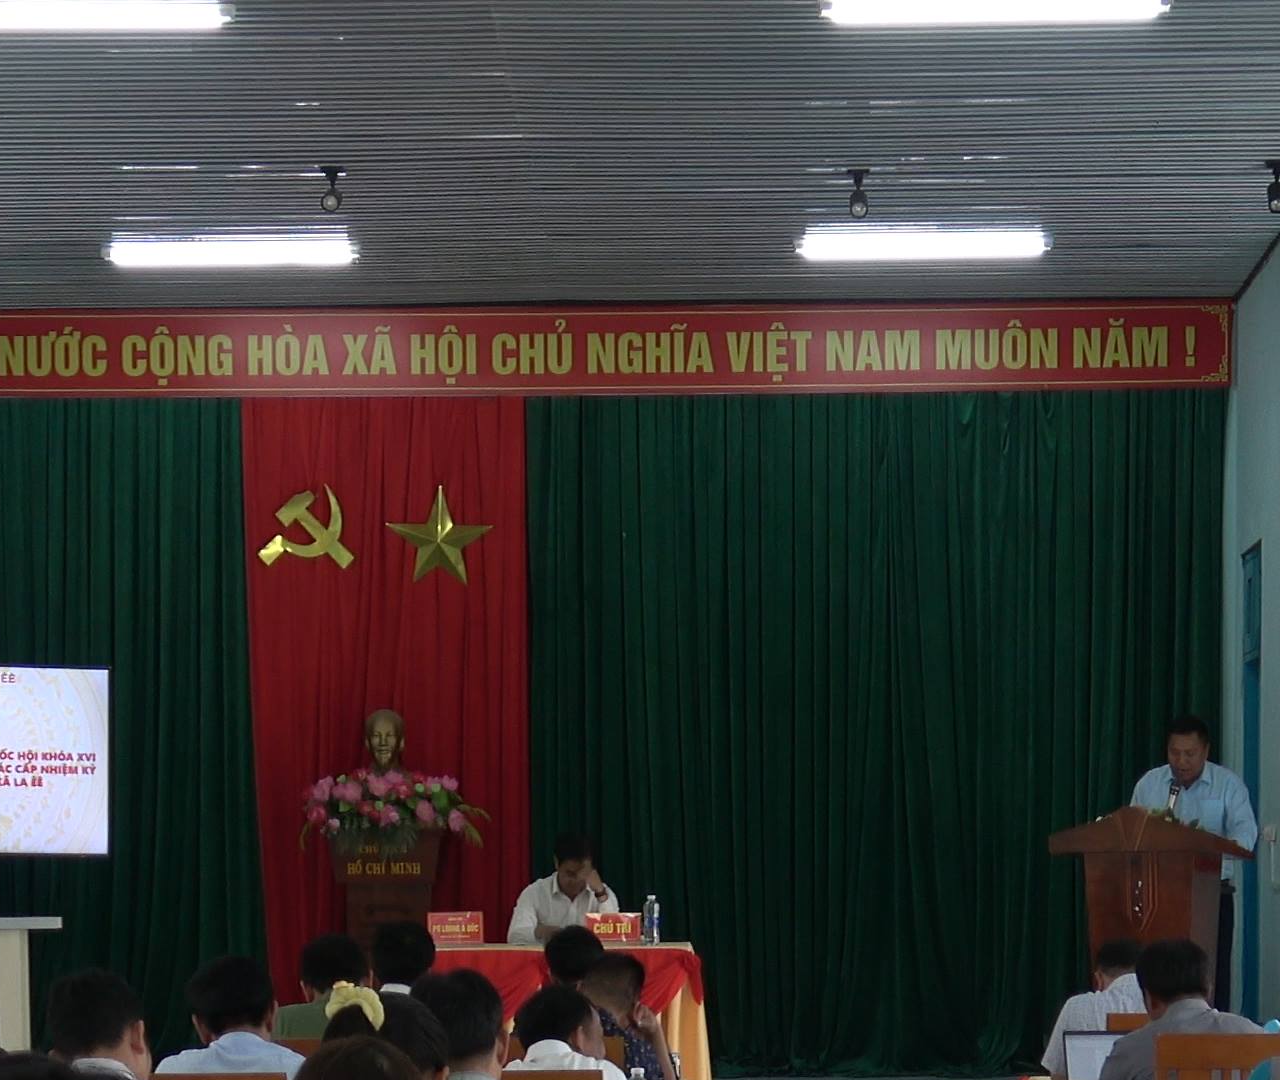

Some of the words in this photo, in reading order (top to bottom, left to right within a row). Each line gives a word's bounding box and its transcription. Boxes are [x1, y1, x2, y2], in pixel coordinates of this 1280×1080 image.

[122, 326, 234, 386] CỘNG
[248, 324, 327, 375] HÒA
[342, 325, 397, 375] XÃ
[411, 325, 475, 385] HỘI
[492, 319, 572, 375] CHỦ
[587, 323, 714, 374] NGHĨA
[727, 322, 813, 382] VIỆT
[826, 330, 921, 372] NAM
[935, 320, 1058, 371] MUÔN
[1072, 318, 1169, 369] NĂM
[18, 750, 38, 763] HỘI
[41, 750, 73, 762] KHÓA
[77, 752, 96, 762] XVI
[40, 763, 78, 776] NHIỆM
[14, 777, 28, 787] LA
[390, 862, 421, 874] MINH
